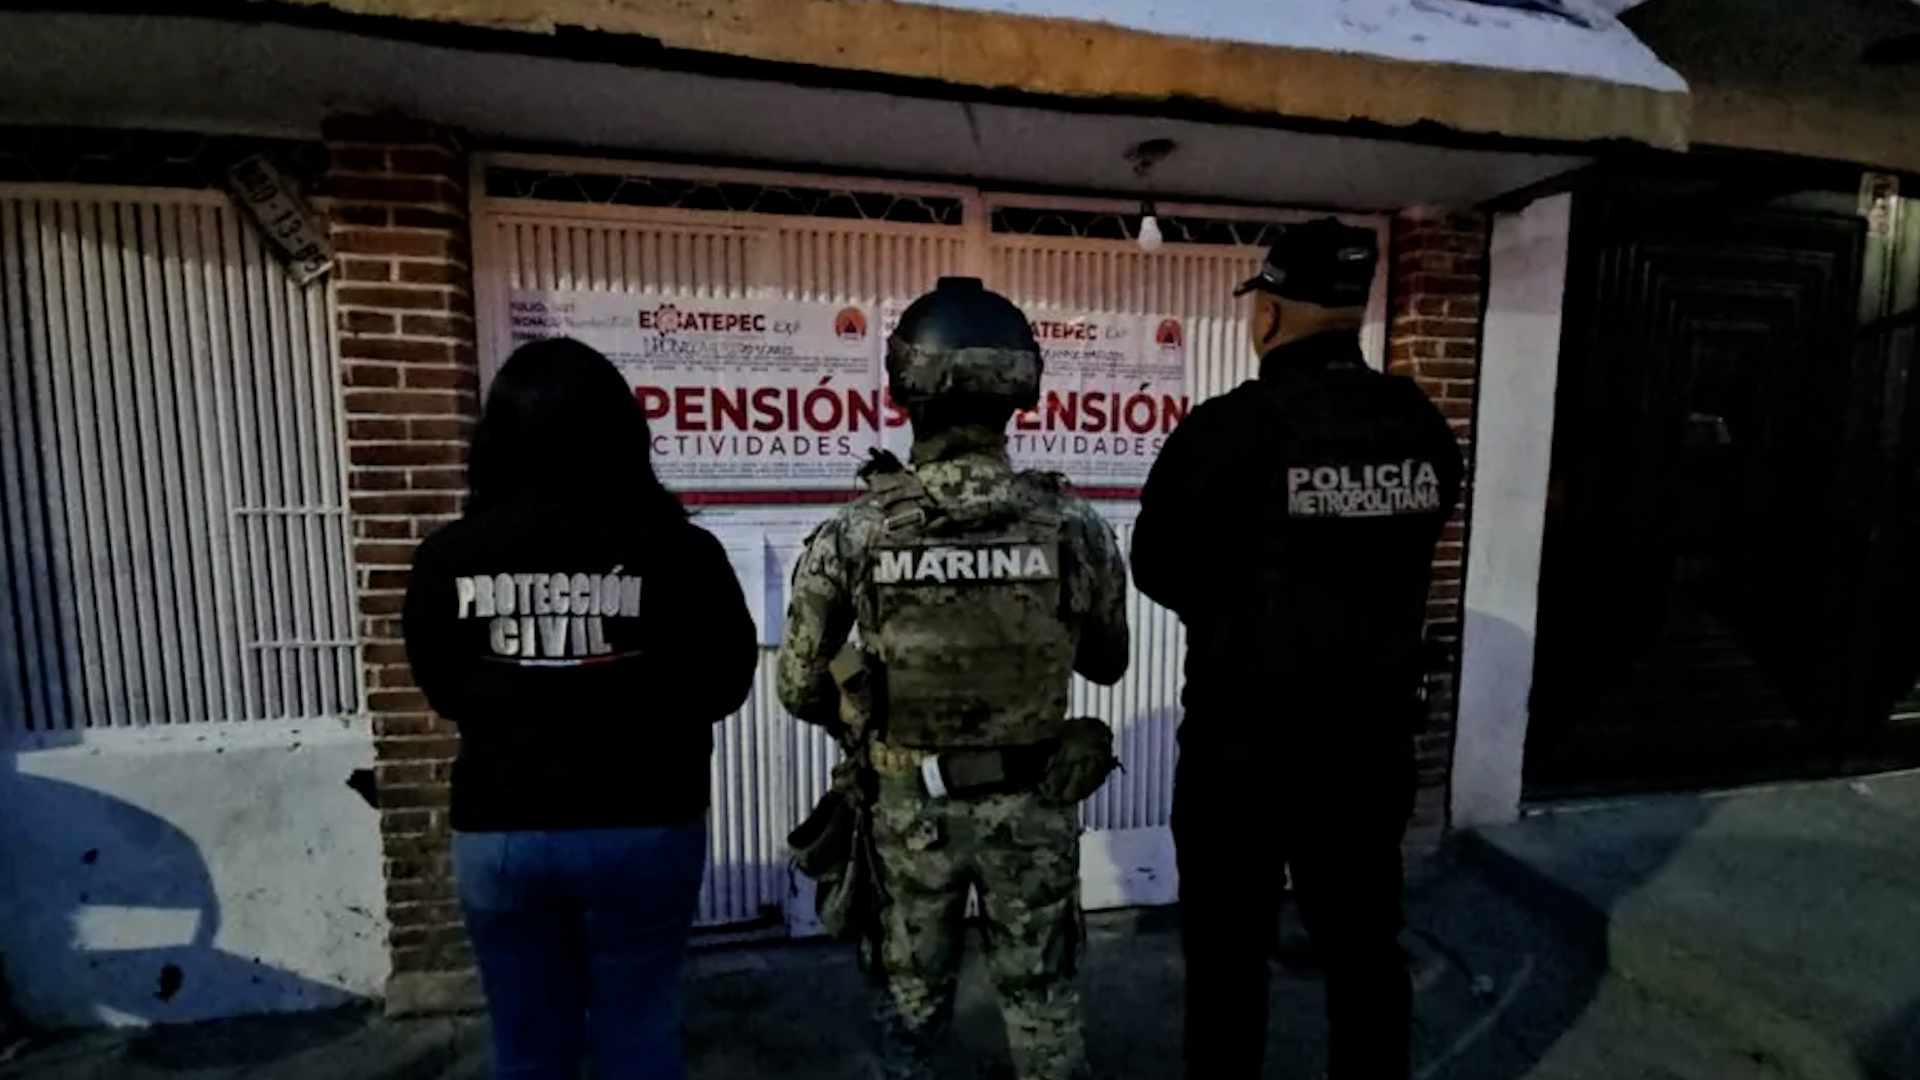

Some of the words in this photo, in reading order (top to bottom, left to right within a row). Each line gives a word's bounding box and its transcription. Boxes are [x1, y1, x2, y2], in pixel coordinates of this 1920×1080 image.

[1006, 434, 1163, 456] TIVIDADES
[1287, 457, 1439, 491] POLICÍA
[1287, 485, 1440, 515] METROPOLITANA
[873, 545, 1052, 583] MARINA
[455, 563, 642, 620] PROTECCIÓN
[488, 614, 614, 657] CIVIL
